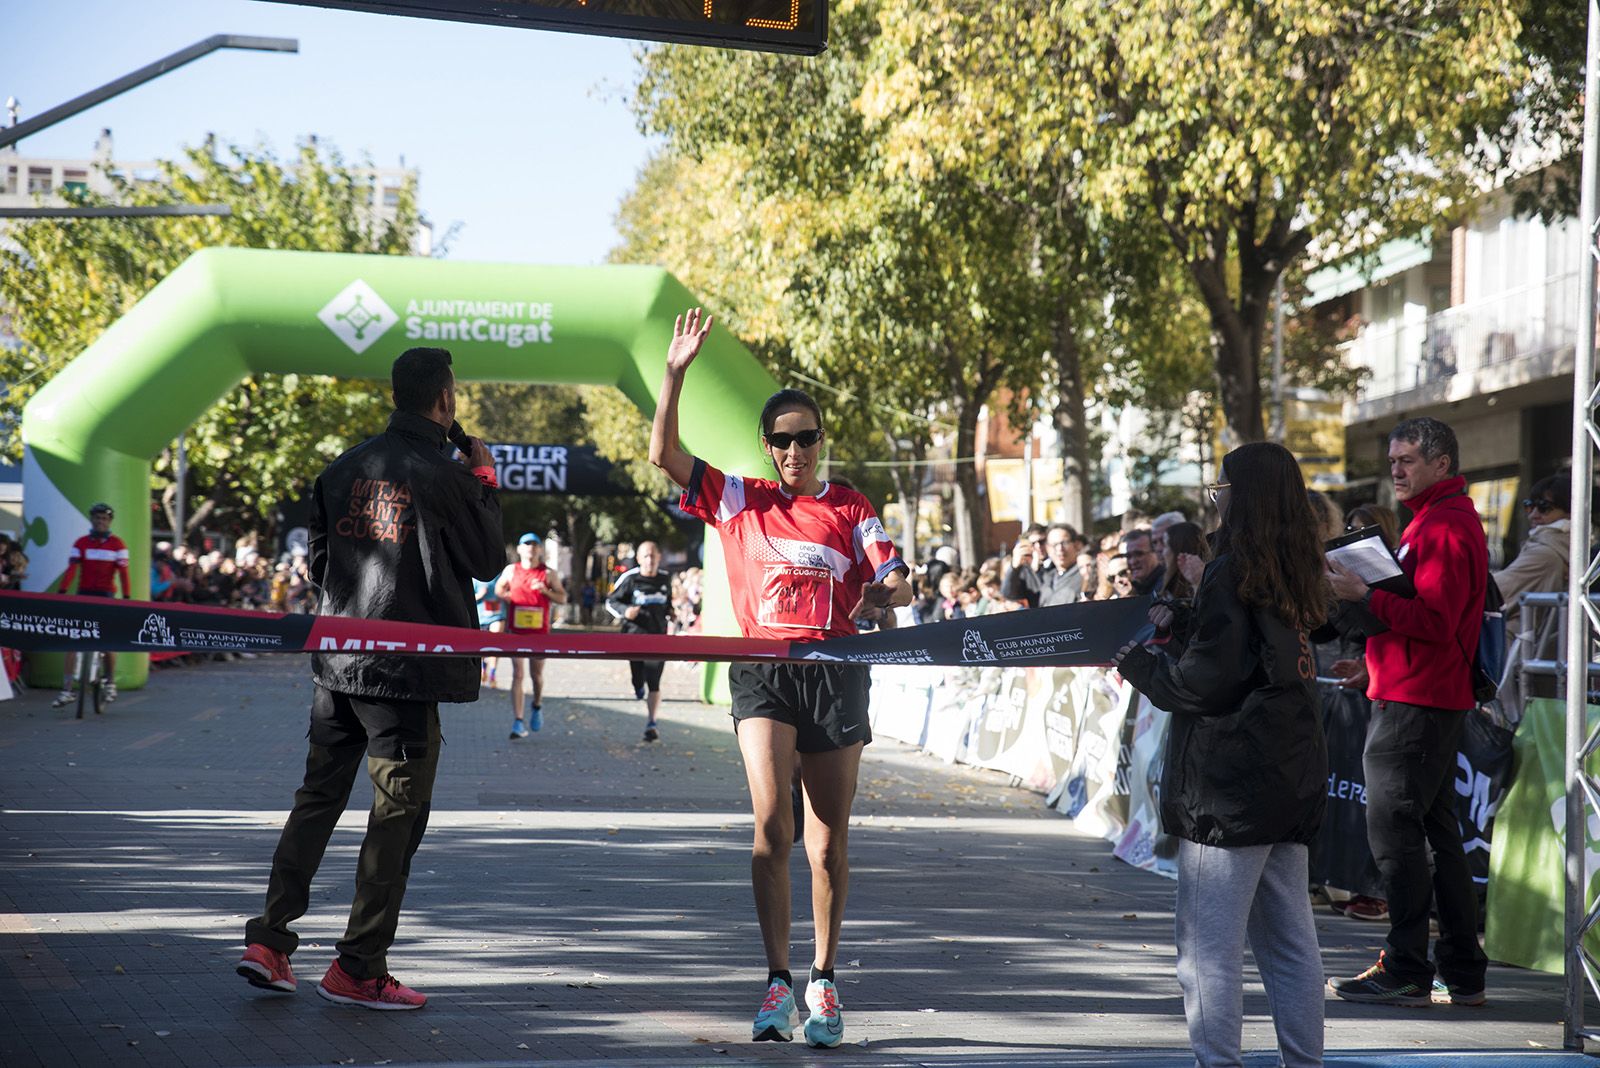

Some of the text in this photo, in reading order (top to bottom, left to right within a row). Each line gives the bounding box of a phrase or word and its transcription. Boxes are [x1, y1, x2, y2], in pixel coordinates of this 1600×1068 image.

[406, 298, 553, 320] AJUNTAMENT DE
[405, 315, 553, 348] SantCugat
[452, 444, 568, 464] ETLLER
[352, 479, 412, 503] MITJA
[349, 498, 408, 522] SANT
[336, 517, 416, 544] CUGAT
[793, 568, 818, 577] CUGAT
[0, 612, 100, 629] AJUNTAMENT DE
[0, 619, 100, 639] SantCugat
[179, 631, 282, 646] CLUB MUNTANYENC
[180, 638, 208, 647] SANT
[995, 632, 1085, 650] CLUB MUNTANYENC
[846, 650, 913, 660] AJUNTAMENT
[999, 646, 1056, 658] SANT CUGAT
